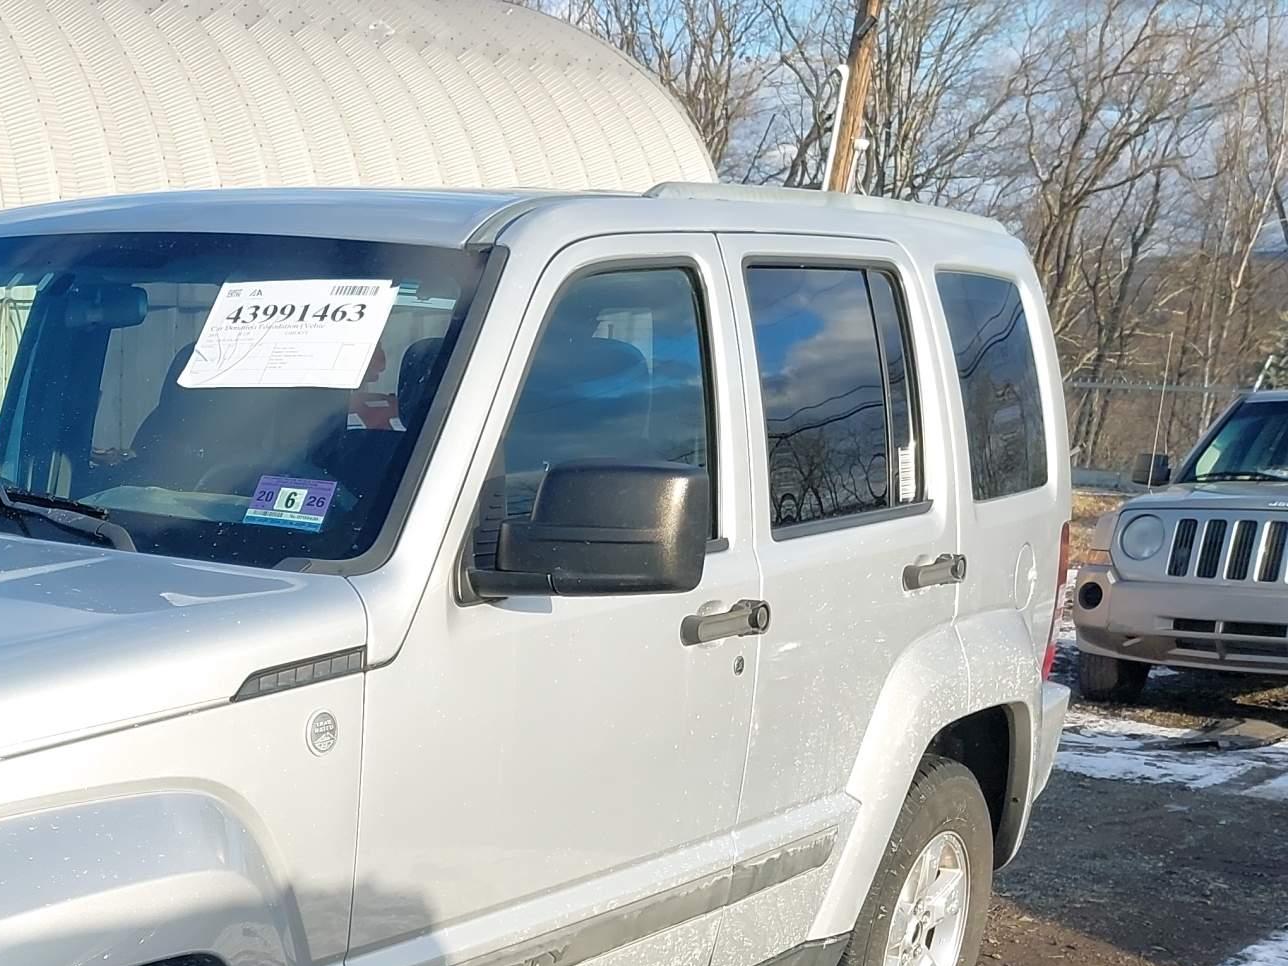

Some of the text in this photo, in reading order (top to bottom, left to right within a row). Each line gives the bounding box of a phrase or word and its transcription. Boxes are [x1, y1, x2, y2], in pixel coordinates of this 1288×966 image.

[226, 303, 367, 324] 43991463
[256, 490, 326, 509] 20 6 26
